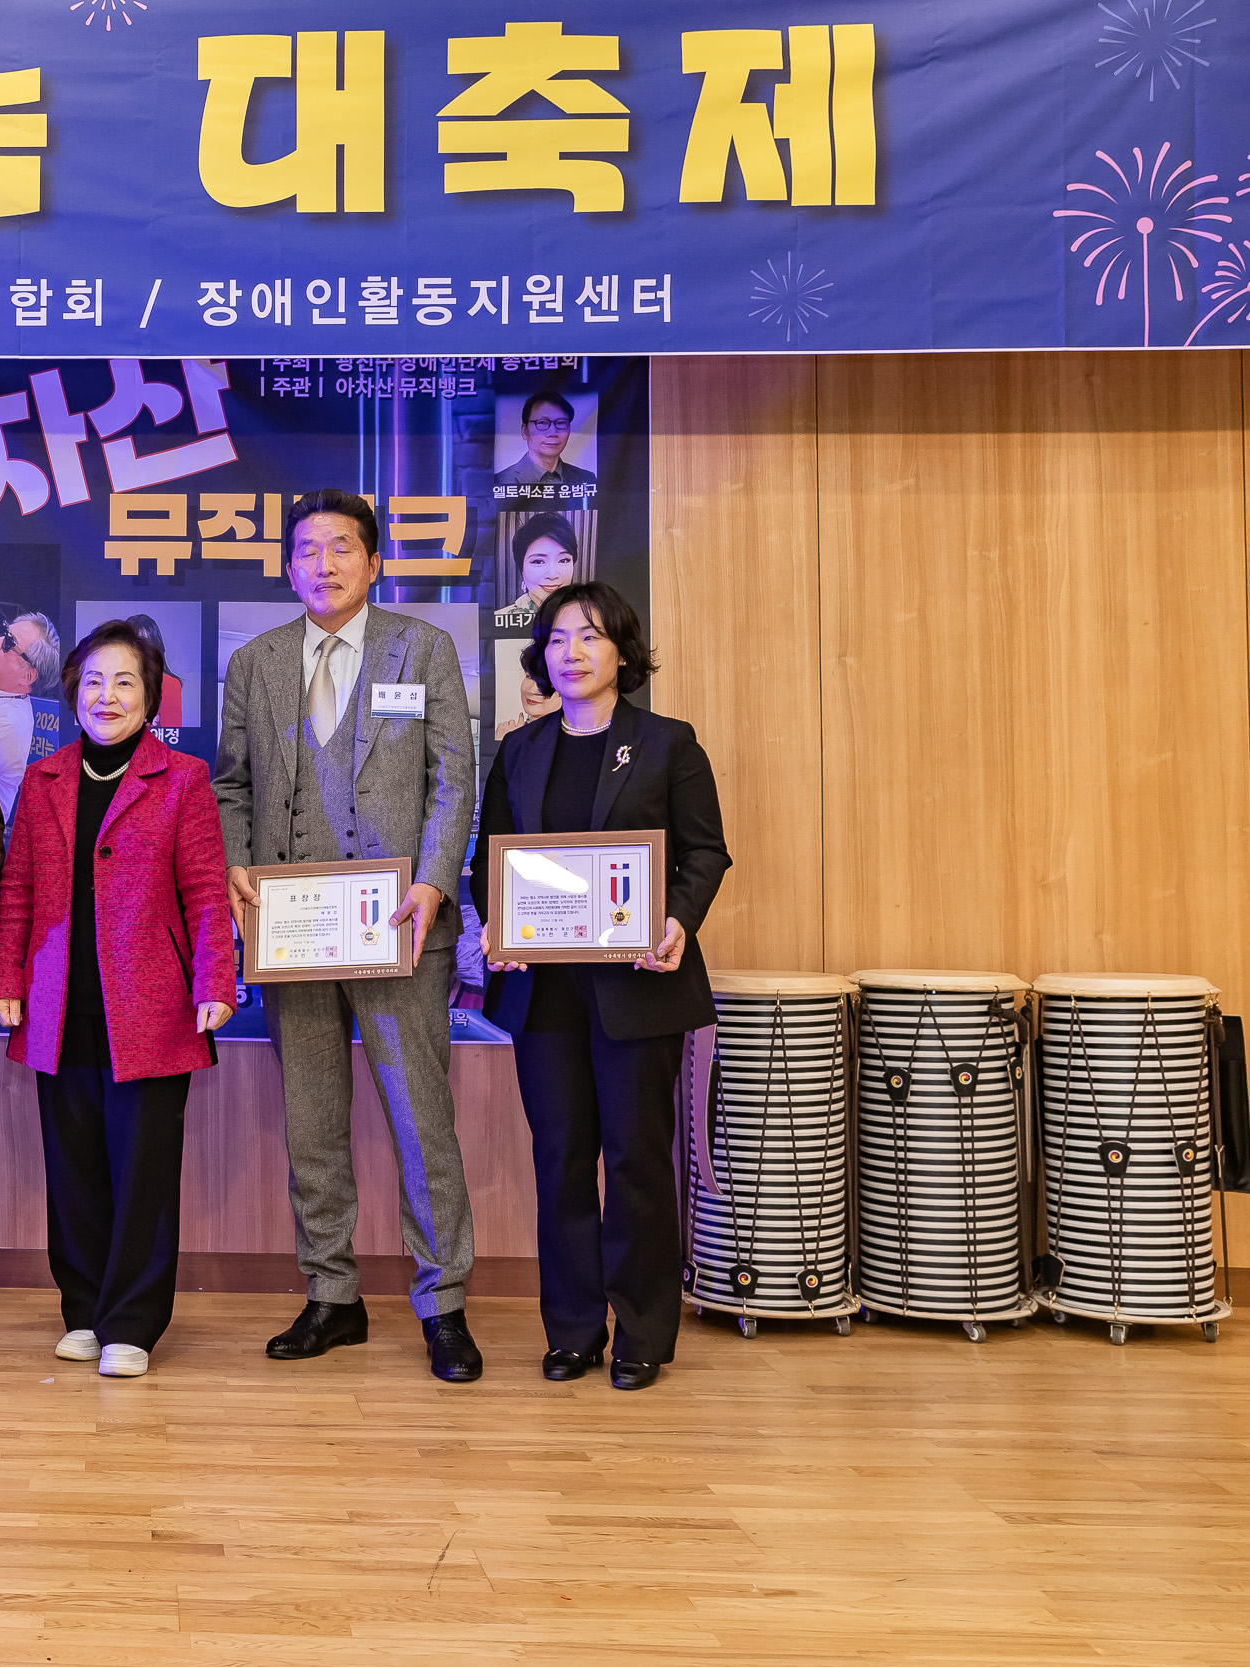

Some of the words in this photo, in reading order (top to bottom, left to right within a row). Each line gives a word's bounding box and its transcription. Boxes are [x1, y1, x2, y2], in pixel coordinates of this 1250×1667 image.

[197, 22, 876, 213] 대축제
[197, 273, 674, 328] 장애인활동지원센터
[273, 377, 311, 397] 주관
[336, 377, 393, 398] 아차산
[399, 377, 477, 398] 뮤직뱅크
[558, 483, 598, 498] 윤범규
[104, 493, 472, 578] 뮤직크
[36, 711, 59, 732] 2024
